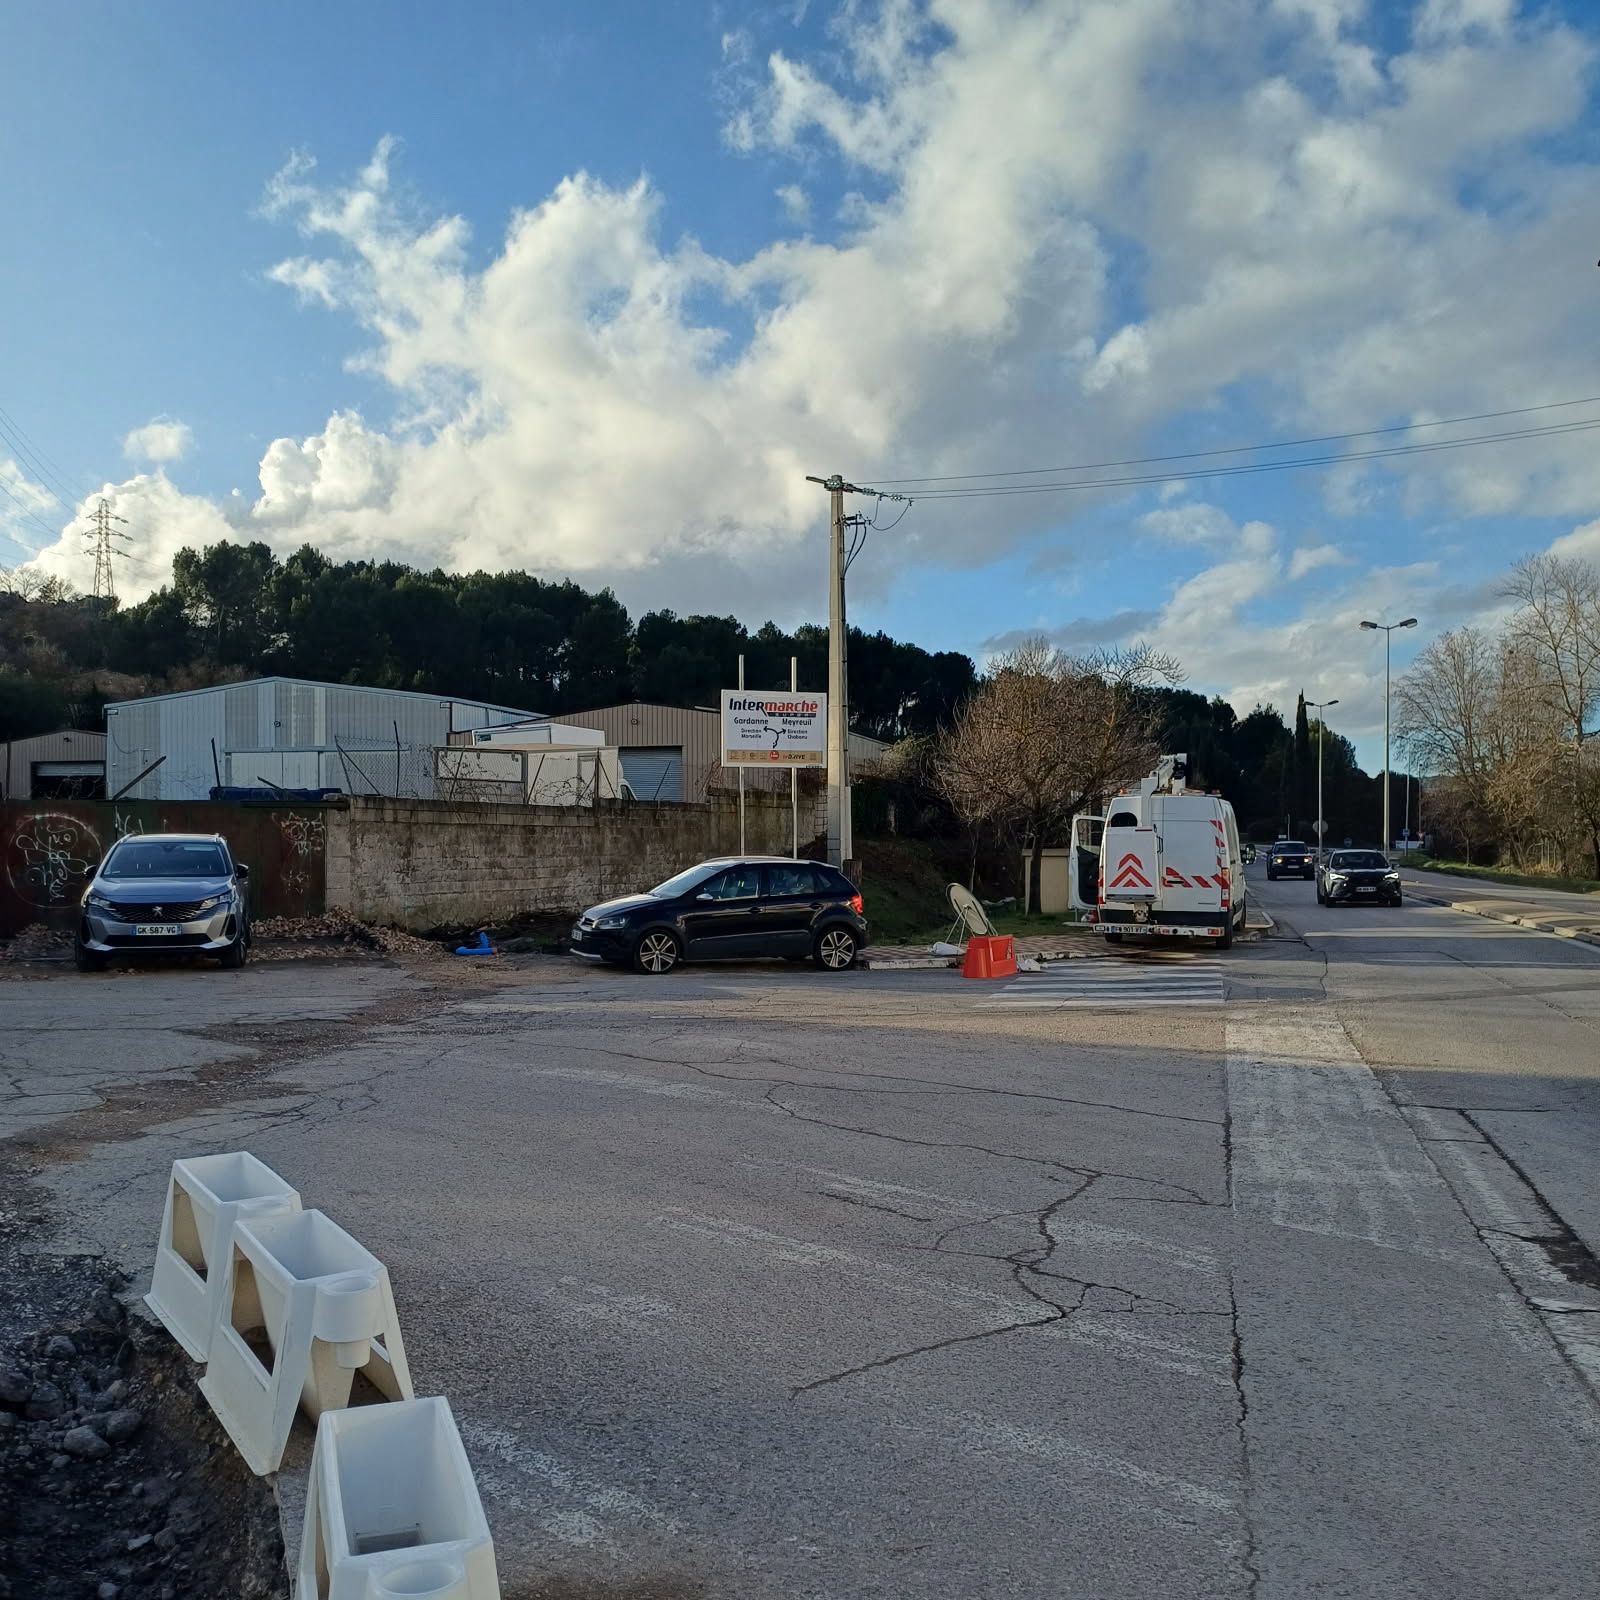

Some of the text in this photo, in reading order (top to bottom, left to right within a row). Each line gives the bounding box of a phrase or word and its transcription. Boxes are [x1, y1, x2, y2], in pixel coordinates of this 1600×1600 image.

[729, 698, 818, 715] Intermarché
[733, 716, 769, 725] Gardanne
[782, 717, 812, 727] Meyreuil
